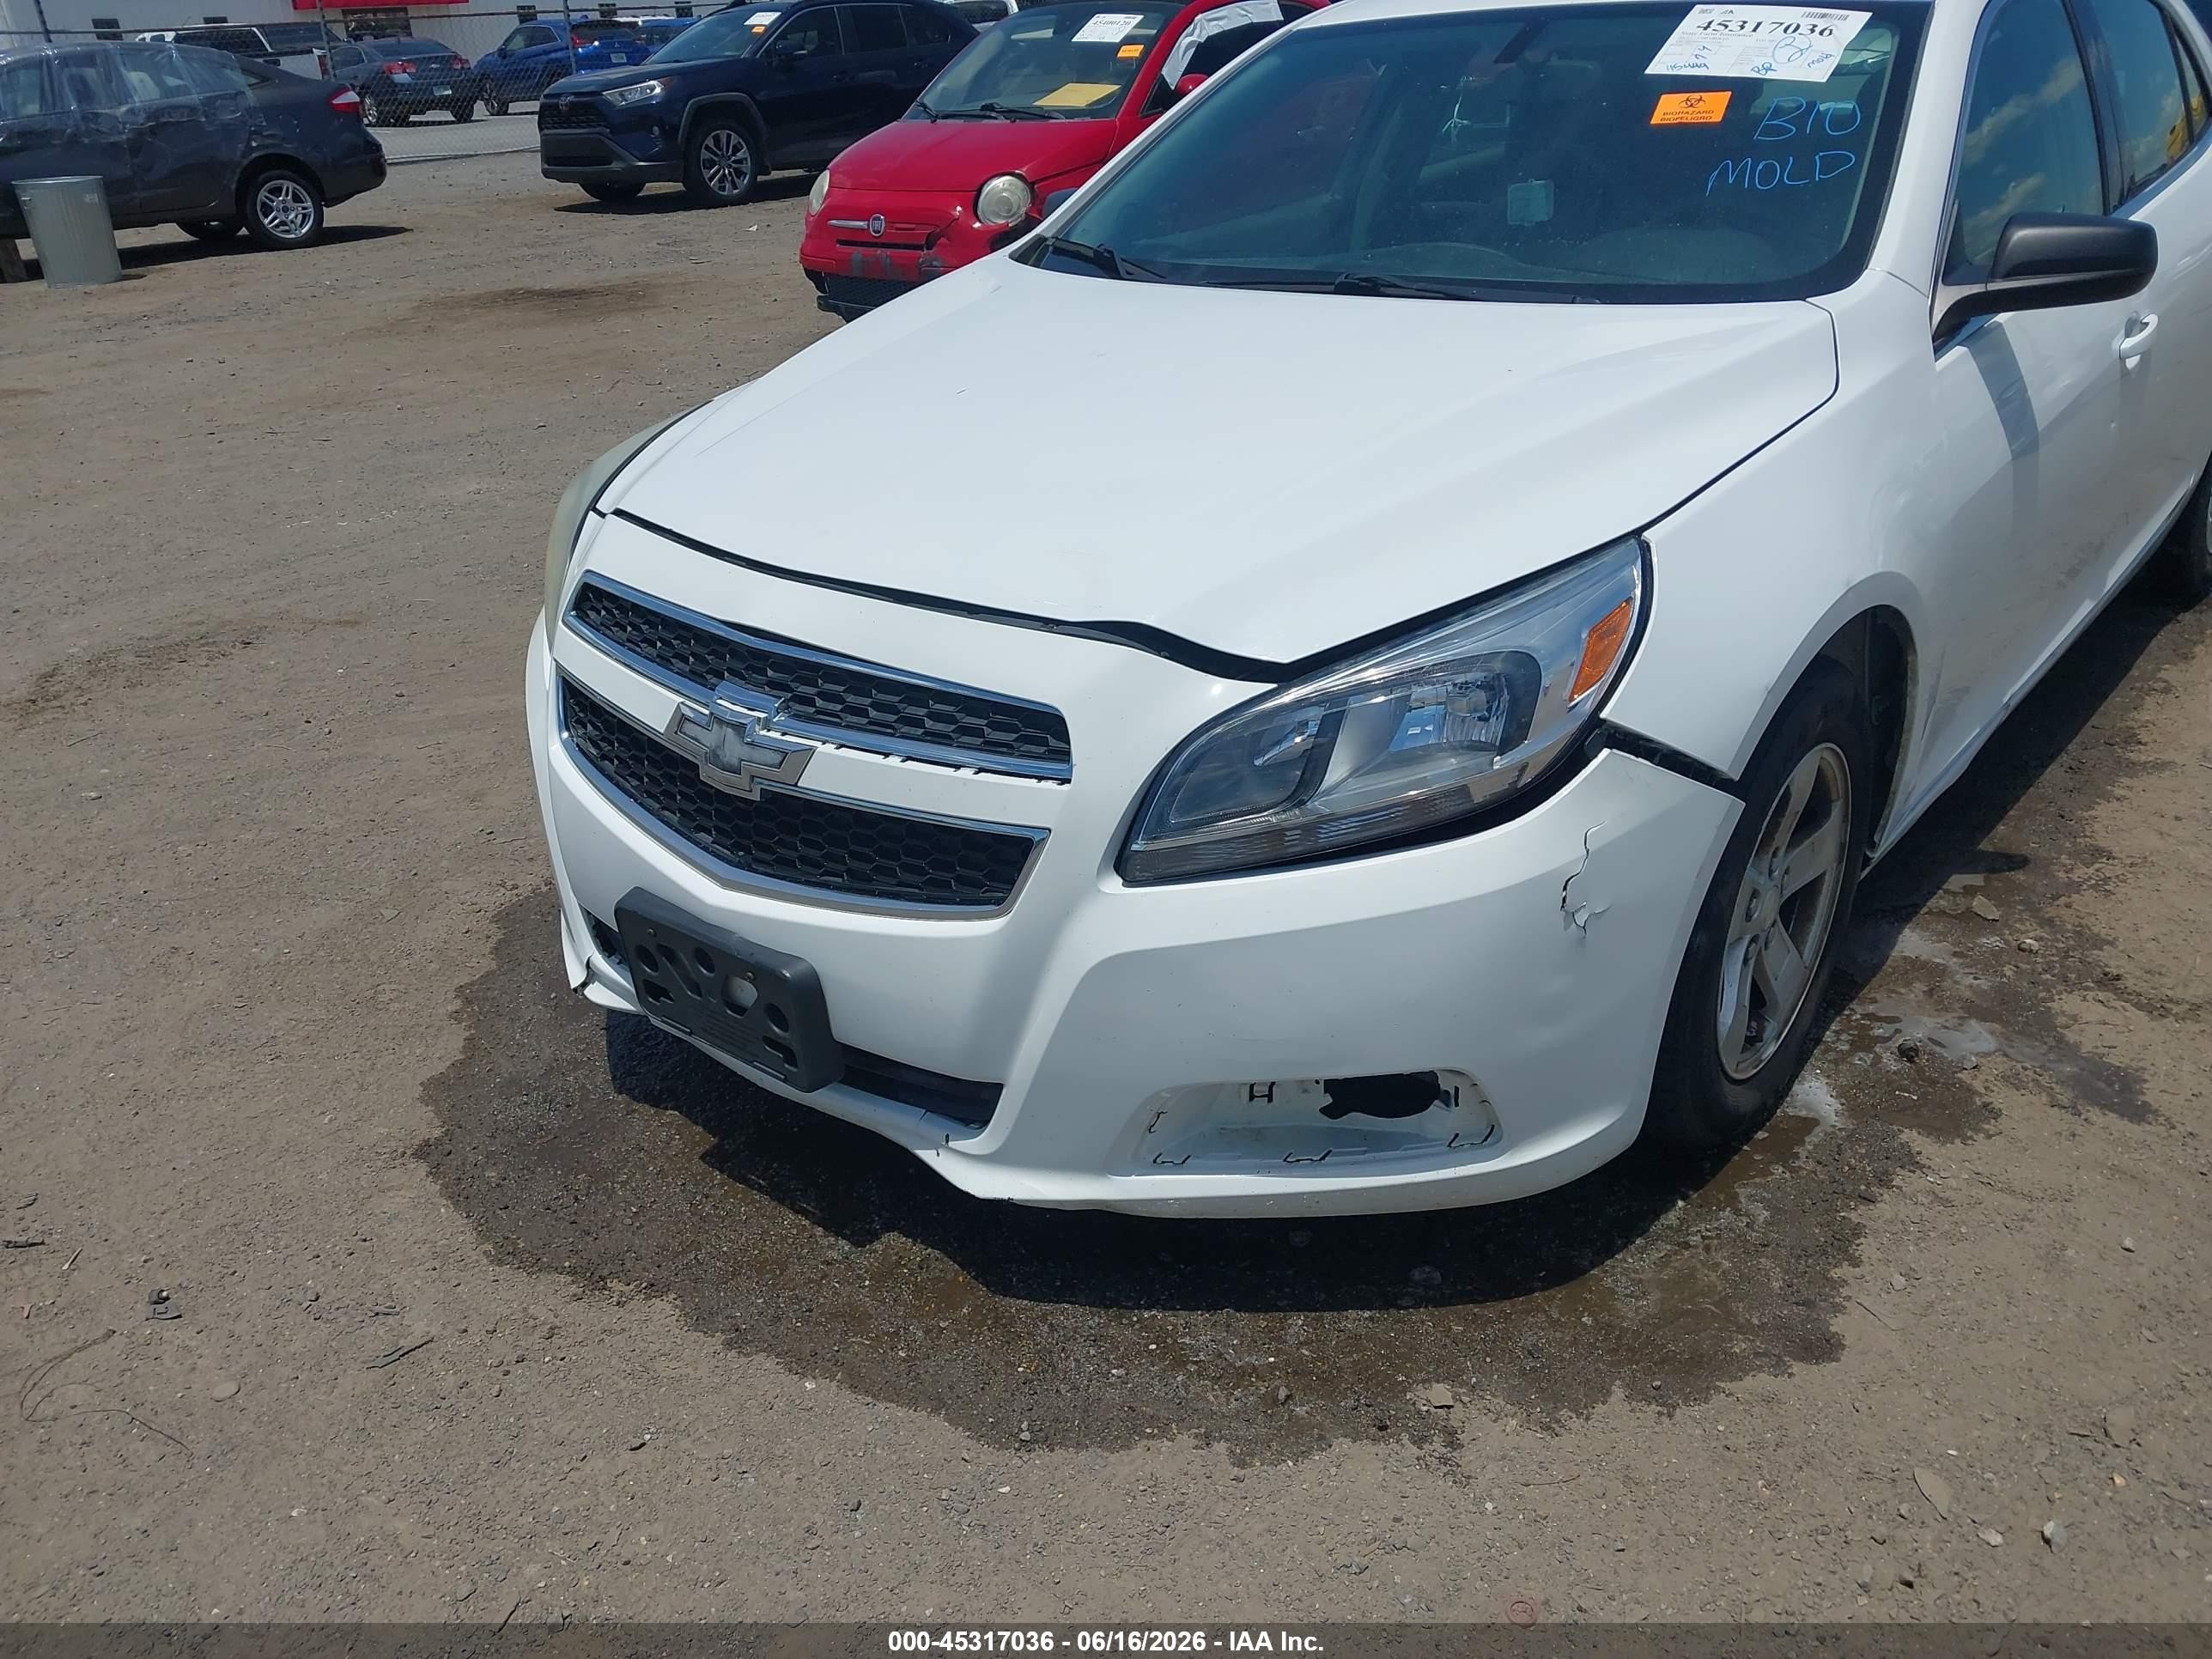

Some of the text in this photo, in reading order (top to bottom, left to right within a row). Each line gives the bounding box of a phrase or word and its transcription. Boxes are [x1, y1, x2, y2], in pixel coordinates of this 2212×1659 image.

[1696, 19, 1834, 38] 45317036
[1753, 96, 1862, 140] BIO
[1705, 150, 1856, 197] MOLD
